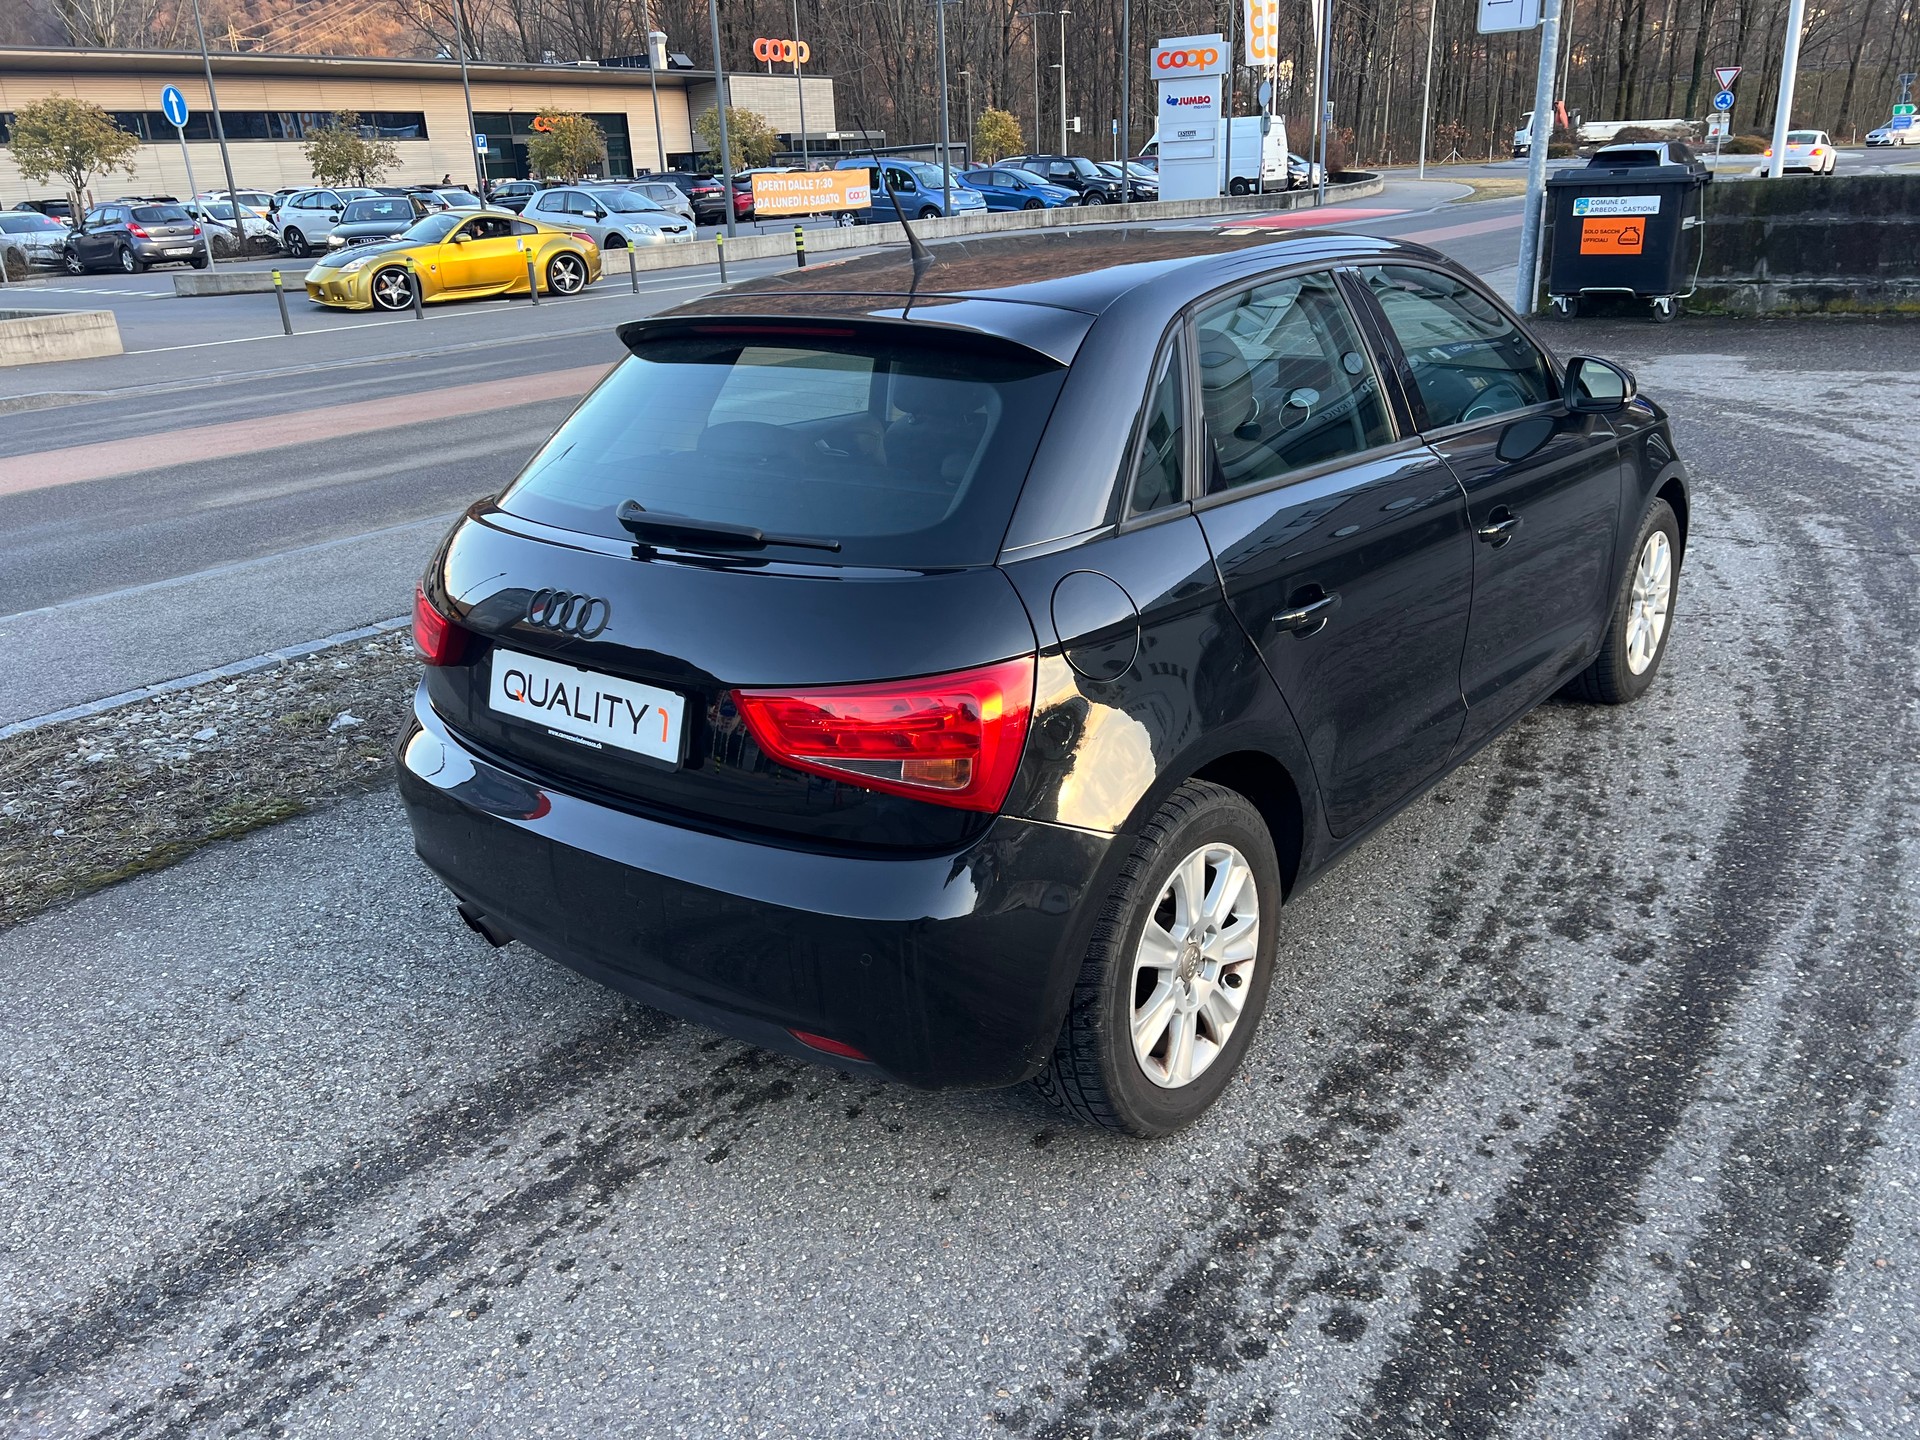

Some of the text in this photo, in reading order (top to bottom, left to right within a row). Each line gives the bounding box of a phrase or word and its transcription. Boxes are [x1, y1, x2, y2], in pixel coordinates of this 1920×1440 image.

[753, 37, 810, 69] coop
[1157, 48, 1218, 71] coop
[1178, 96, 1211, 105] JUMBO
[757, 178, 833, 192] APERTI DALLE 7:30
[757, 193, 840, 209] DA LUNEDÌ A SABATO
[848, 190, 868, 201] coop
